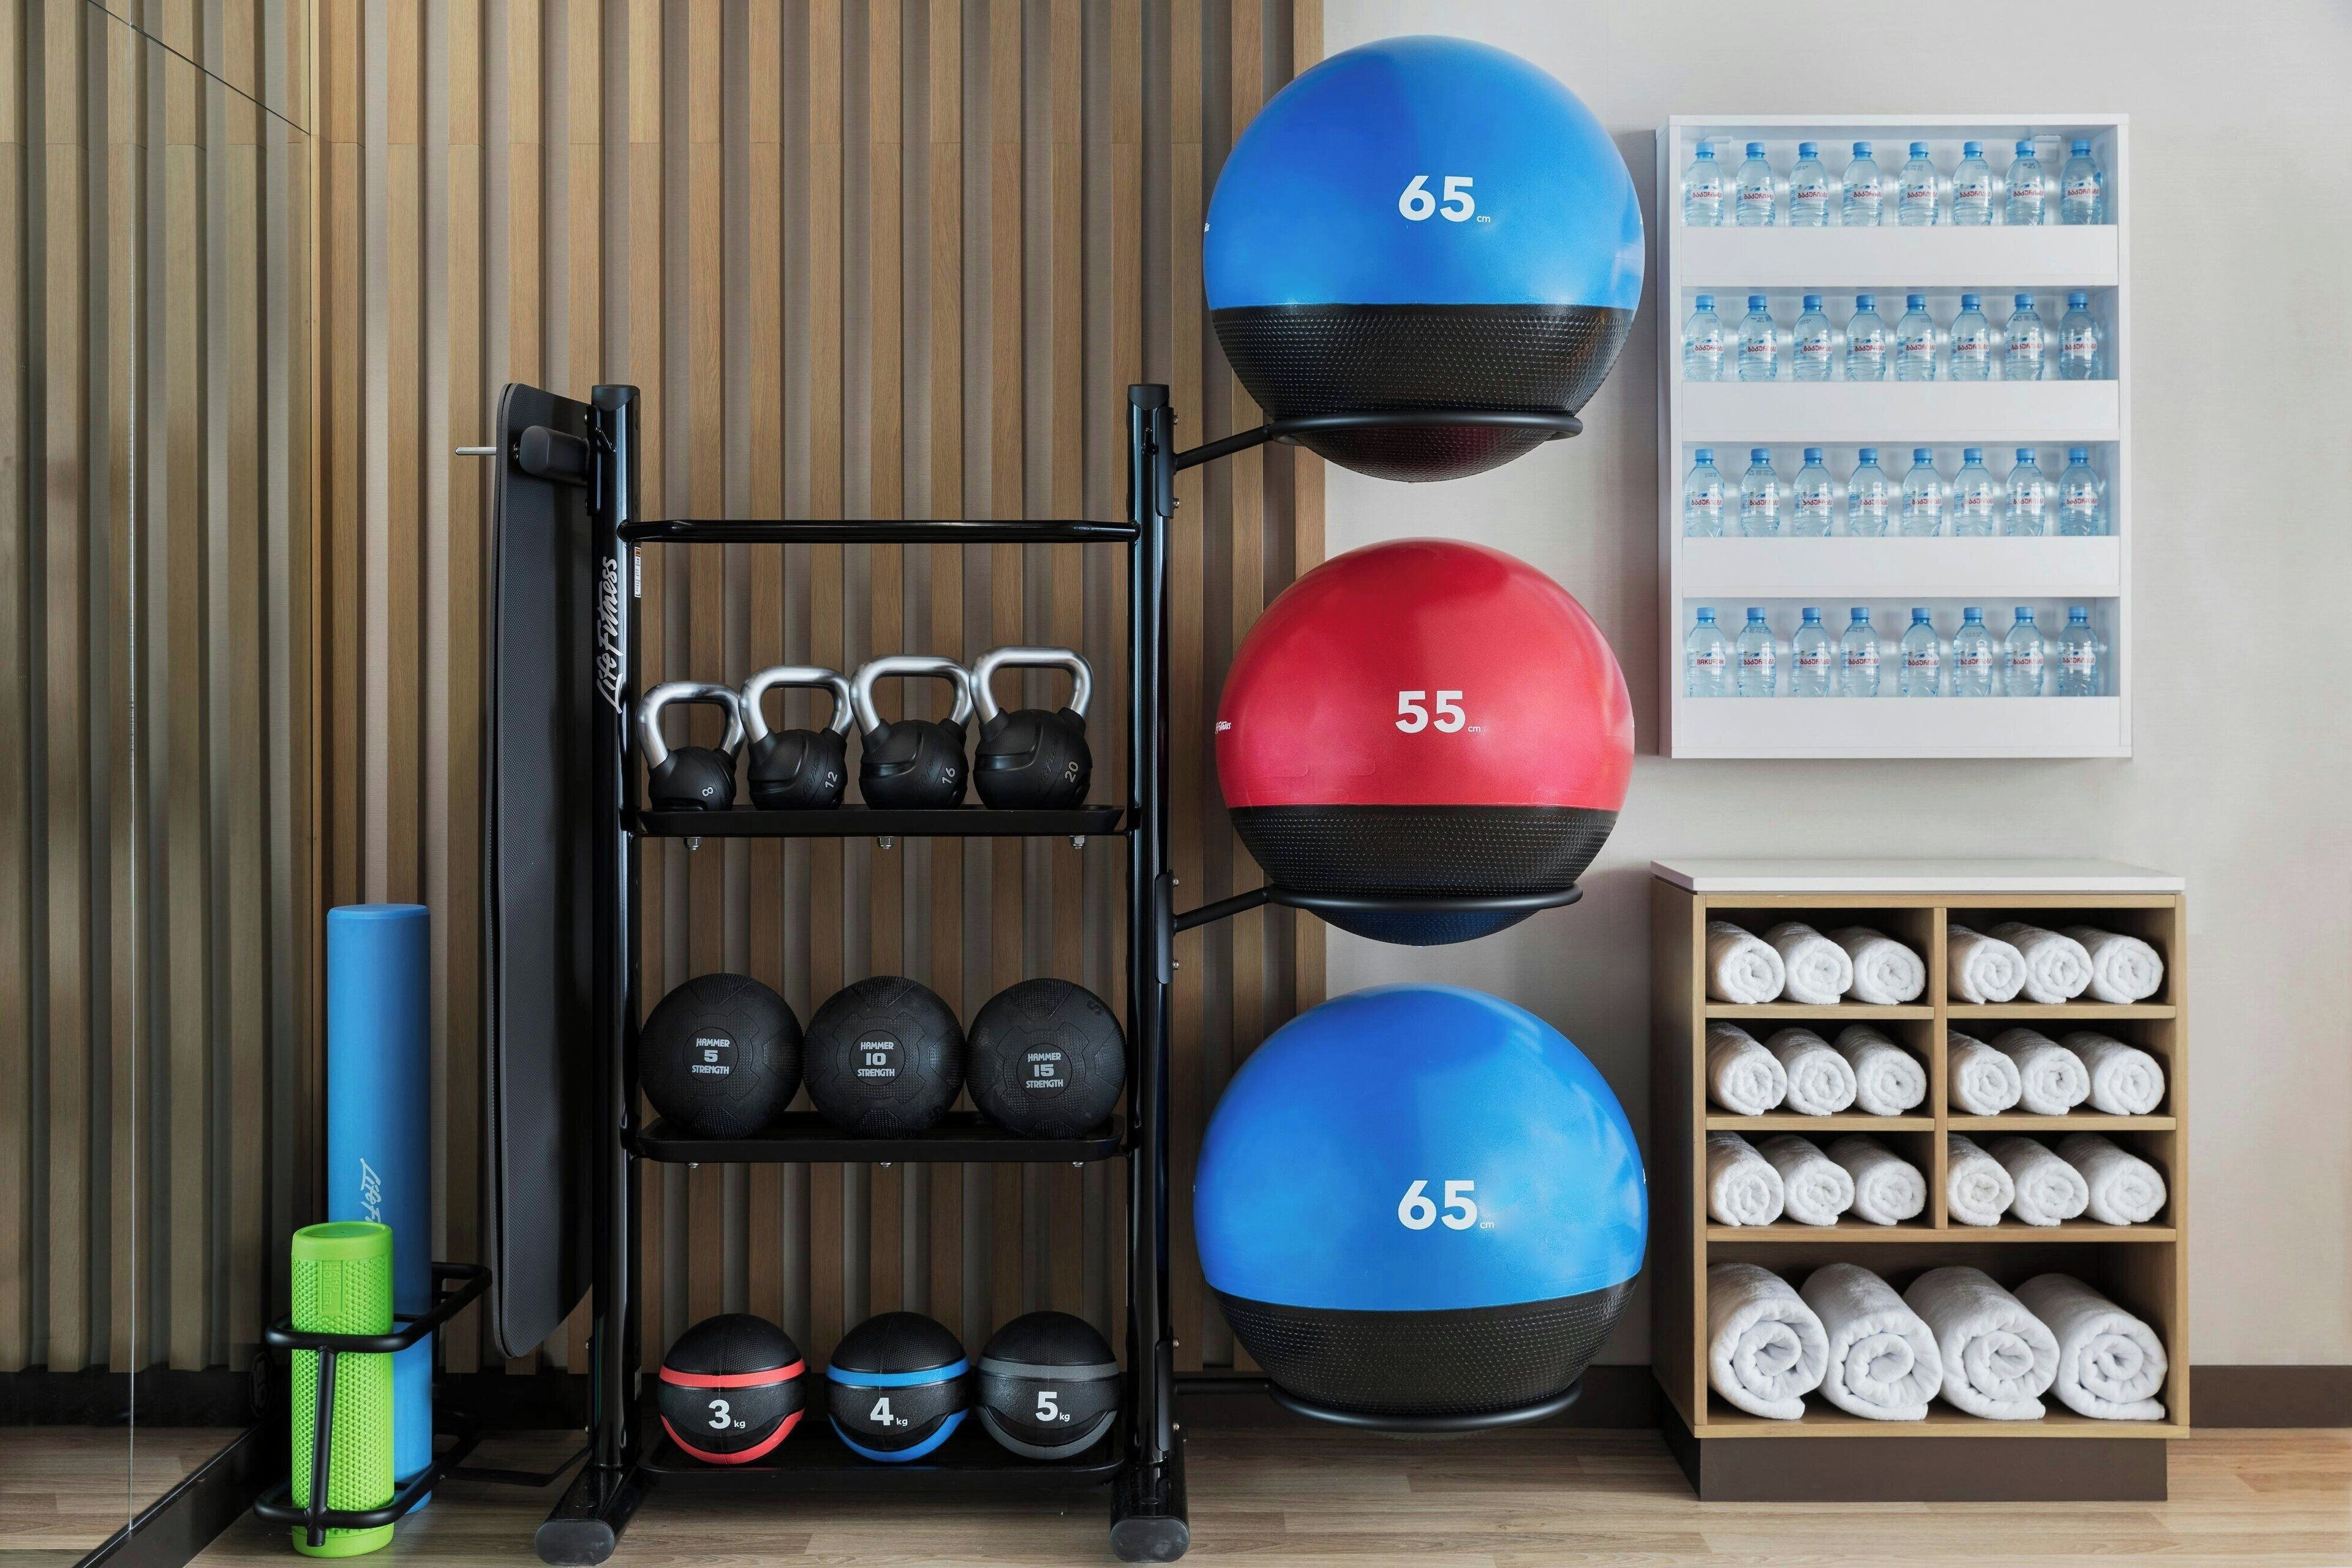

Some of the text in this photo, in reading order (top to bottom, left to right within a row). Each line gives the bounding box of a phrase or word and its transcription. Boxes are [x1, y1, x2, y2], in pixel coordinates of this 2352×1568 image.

[1399, 176, 1475, 222] 65
[597, 557, 624, 714] Life Fitness
[1395, 691, 1466, 733] 55
[825, 771, 838, 788] 12
[942, 767, 956, 784] 16
[1065, 761, 1079, 783] 20
[702, 786, 714, 797] 8
[696, 1038, 730, 1047] HAMMER
[860, 1041, 894, 1051] HAMMER
[704, 1049, 718, 1063] 5
[865, 1052, 886, 1065] 10
[1028, 1052, 1061, 1063] HAMMER
[692, 1065, 729, 1074] STRENGTH
[858, 1068, 895, 1077] STRENGTH
[1034, 1064, 1054, 1077] 15
[1025, 1079, 1064, 1088] STRENGTH
[1398, 1180, 1477, 1230] 65
[708, 1399, 746, 1429] 3 kg
[870, 1397, 908, 1427] 4 kg
[1036, 1391, 1070, 1422] 5 kg
